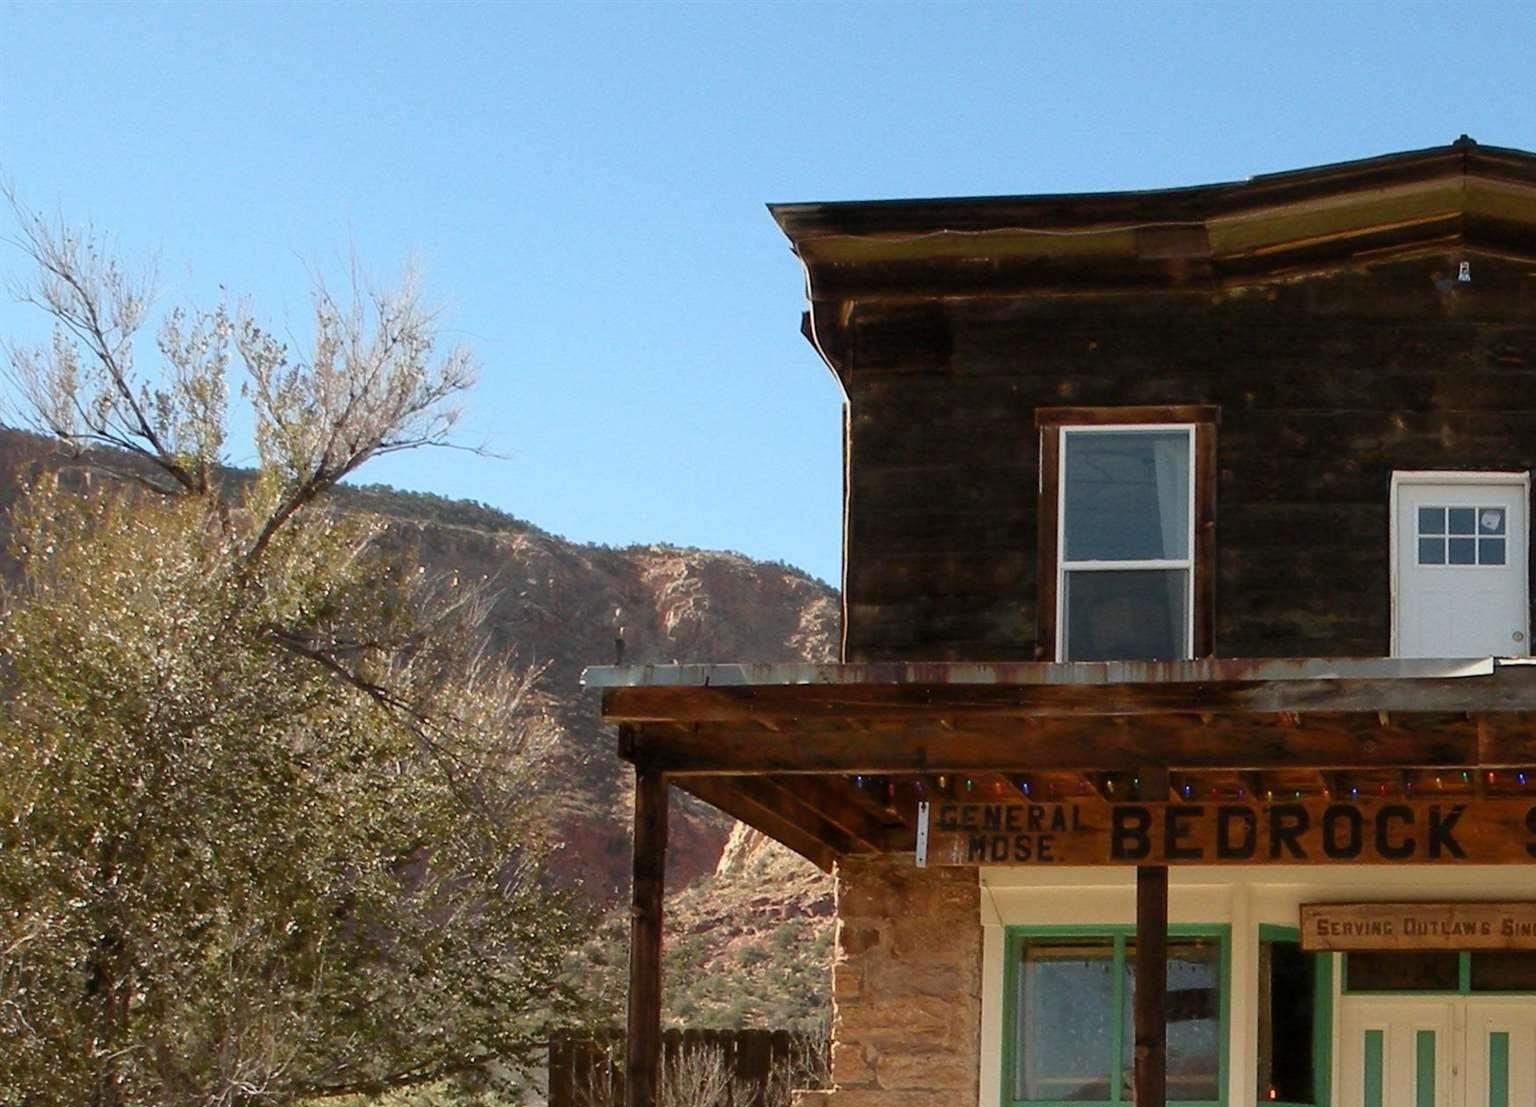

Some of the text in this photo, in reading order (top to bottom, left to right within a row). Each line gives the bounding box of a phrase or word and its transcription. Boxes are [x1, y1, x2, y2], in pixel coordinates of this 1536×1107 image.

[938, 804, 1087, 832] GENERAL
[1110, 803, 1468, 860] BEDROCK
[1316, 918, 1393, 936] SERVING
[1403, 918, 1491, 936] OUTLAWS
